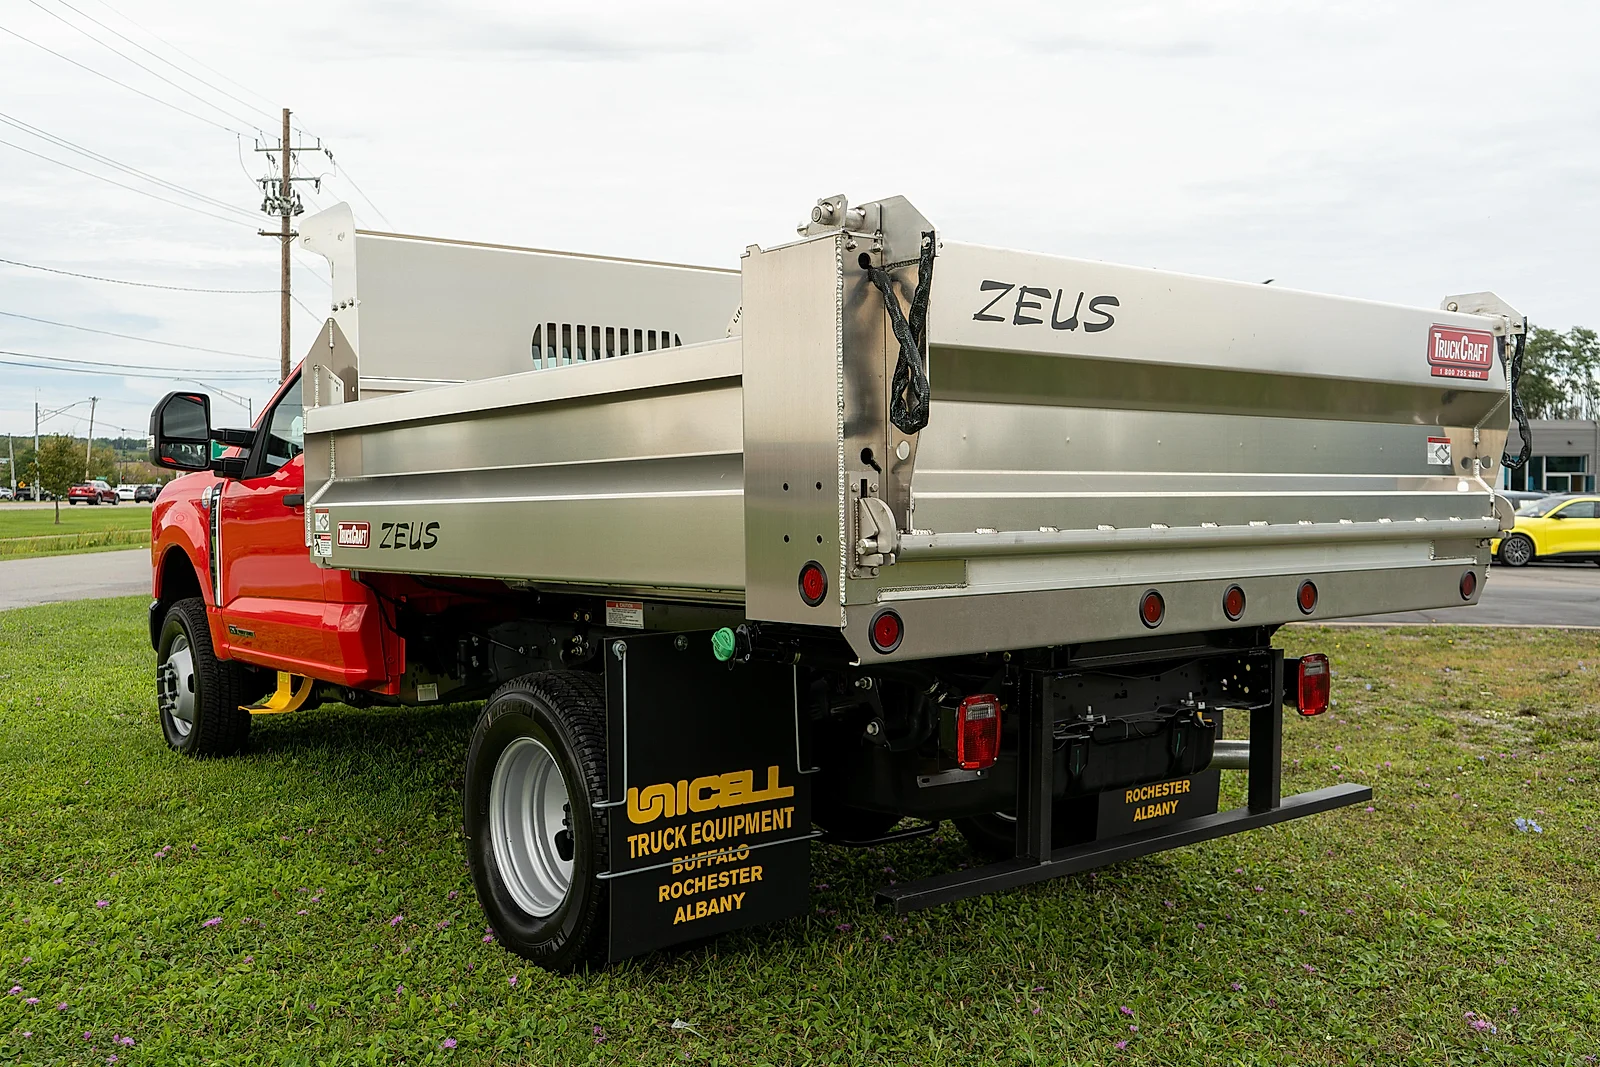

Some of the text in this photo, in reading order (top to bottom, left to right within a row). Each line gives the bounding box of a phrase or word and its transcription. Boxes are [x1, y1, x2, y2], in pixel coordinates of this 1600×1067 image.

[973, 280, 1120, 332] ZEUS
[1434, 332, 1488, 362] TRUCKCRAFT
[379, 521, 440, 550] ZEUS
[627, 765, 795, 824] UNICELL
[1125, 780, 1191, 804] ROCHESTER
[1133, 800, 1179, 822] ALBANY
[627, 806, 795, 859] TRUCK EQUIPMENT
[672, 843, 750, 875] BUFFALO
[658, 865, 763, 902] ROCHESTER
[673, 892, 746, 925] ALBANY
